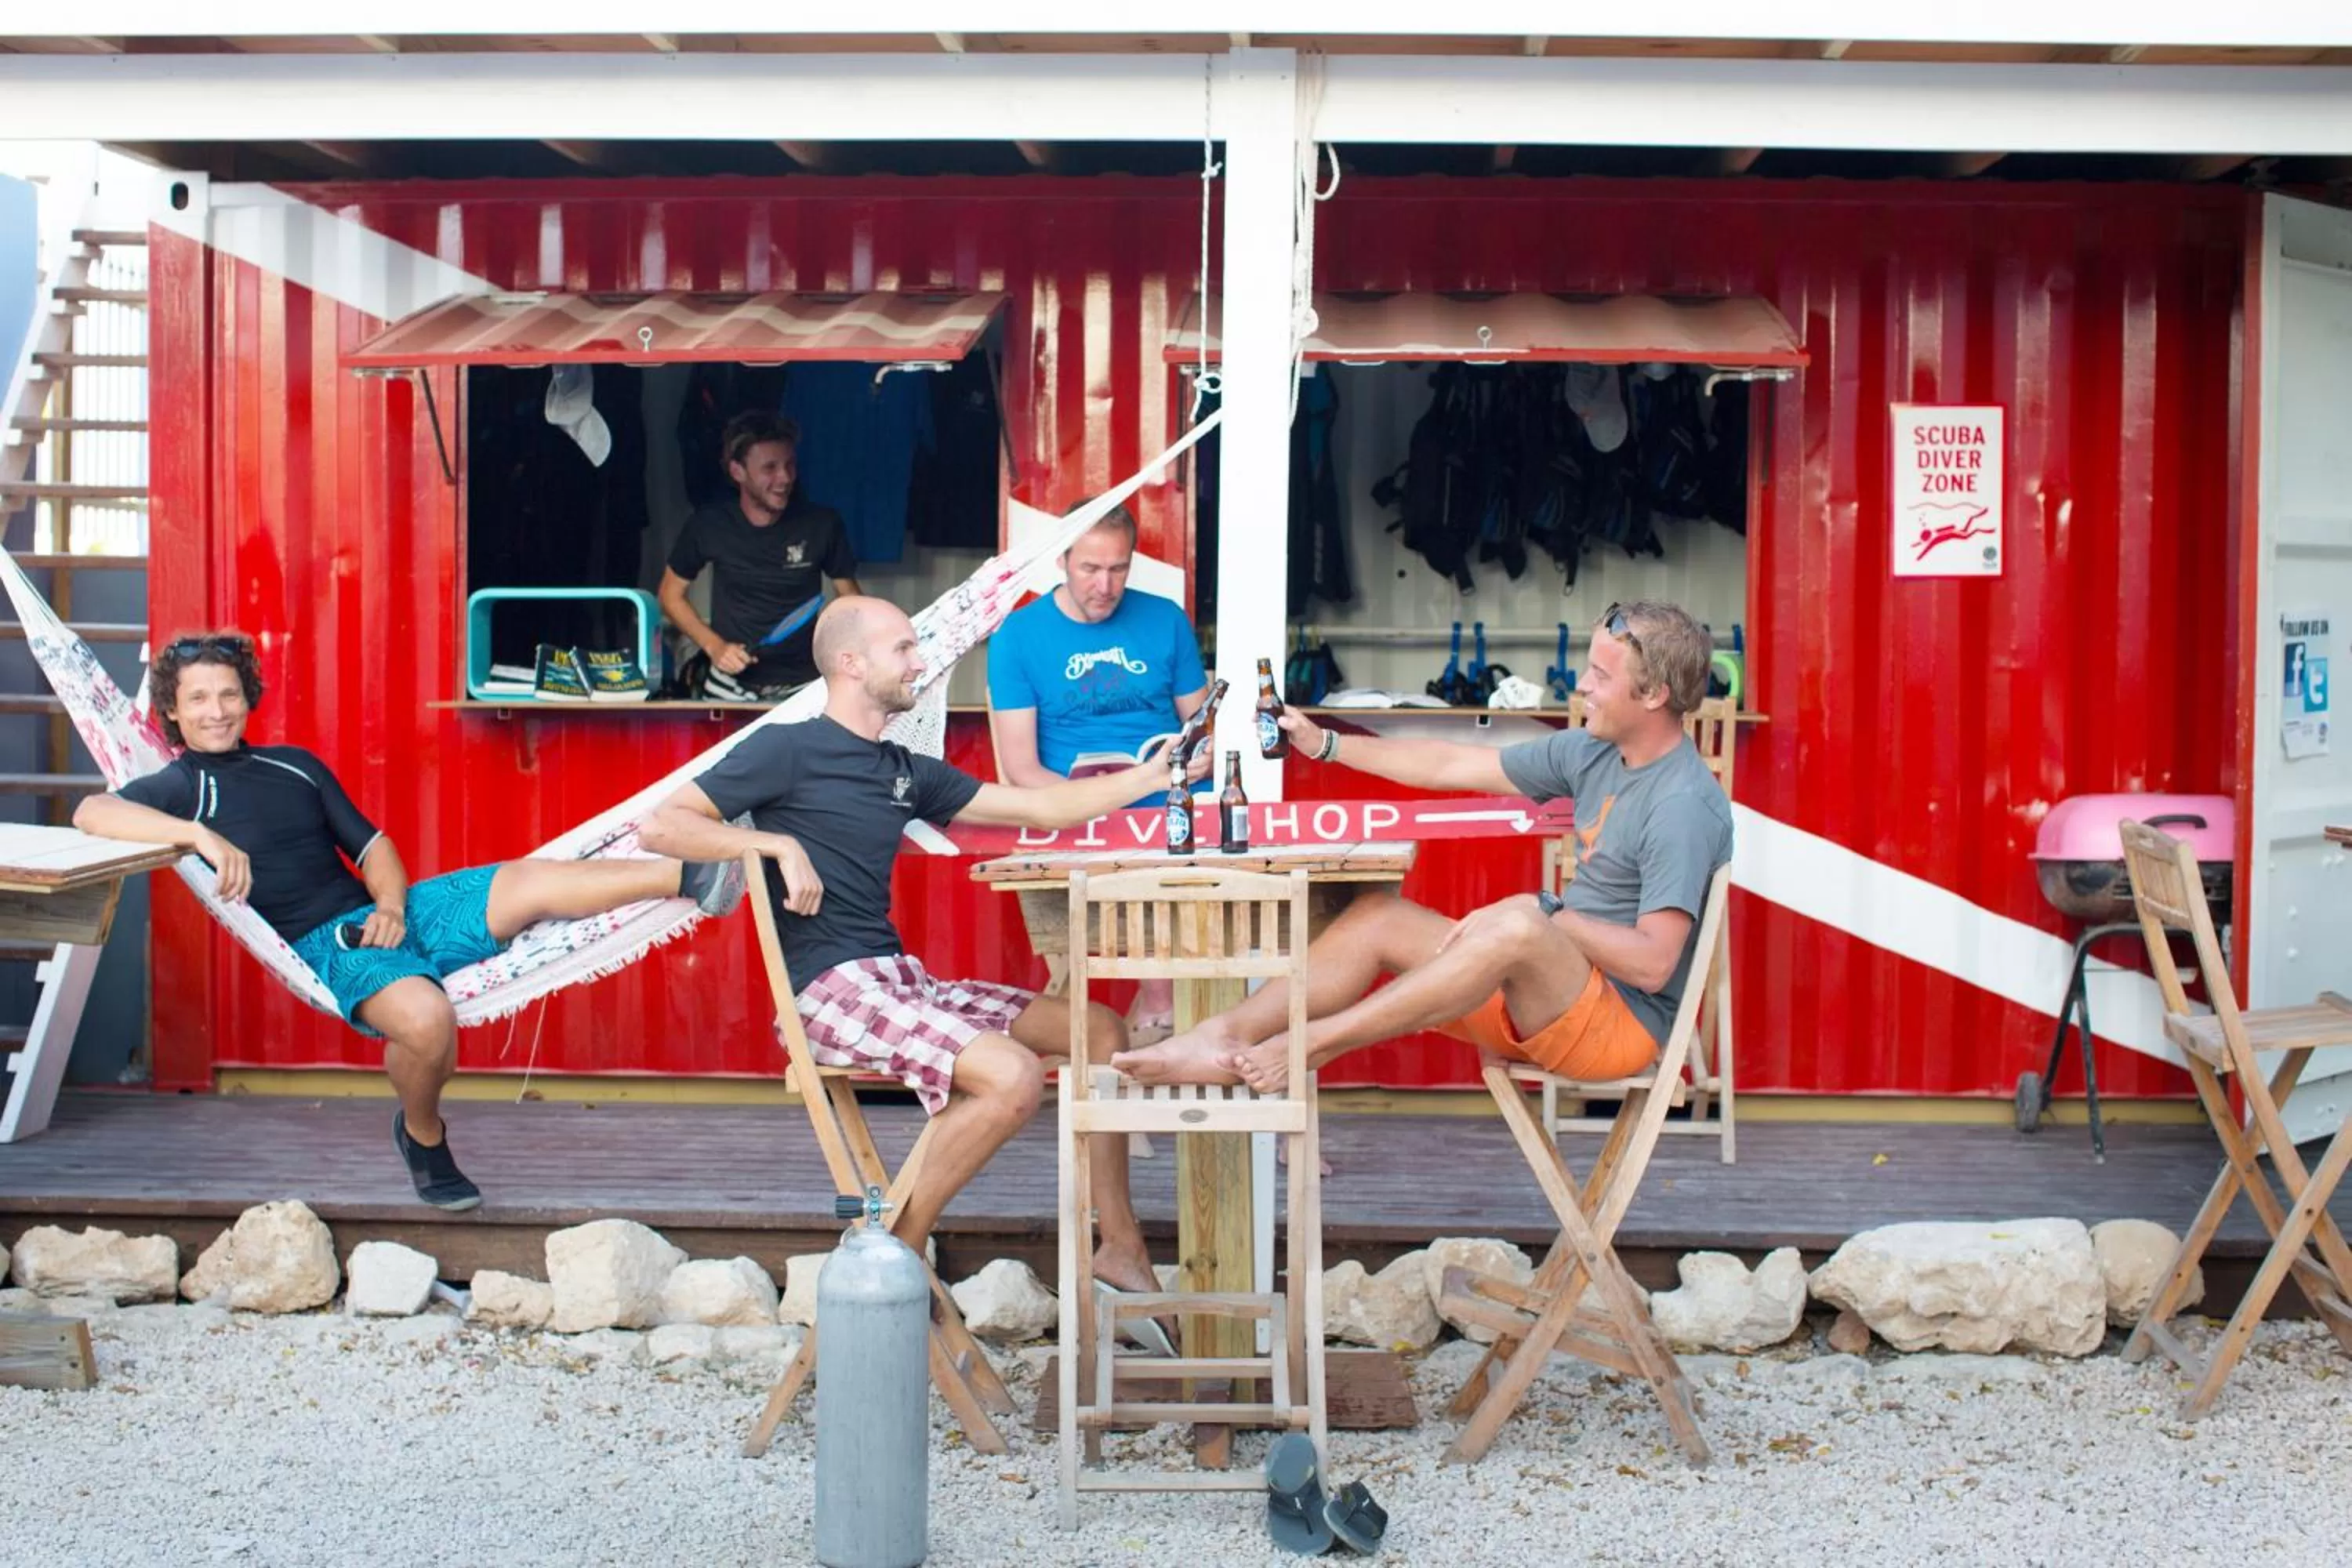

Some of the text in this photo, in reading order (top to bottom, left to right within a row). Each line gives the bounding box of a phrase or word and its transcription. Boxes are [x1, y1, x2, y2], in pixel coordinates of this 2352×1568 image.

[1914, 426, 1986, 445] SCUBA
[1918, 450, 1982, 469] DIVER
[1922, 474, 1978, 493] ZONE
[1218, 803, 1401, 840] HOP
